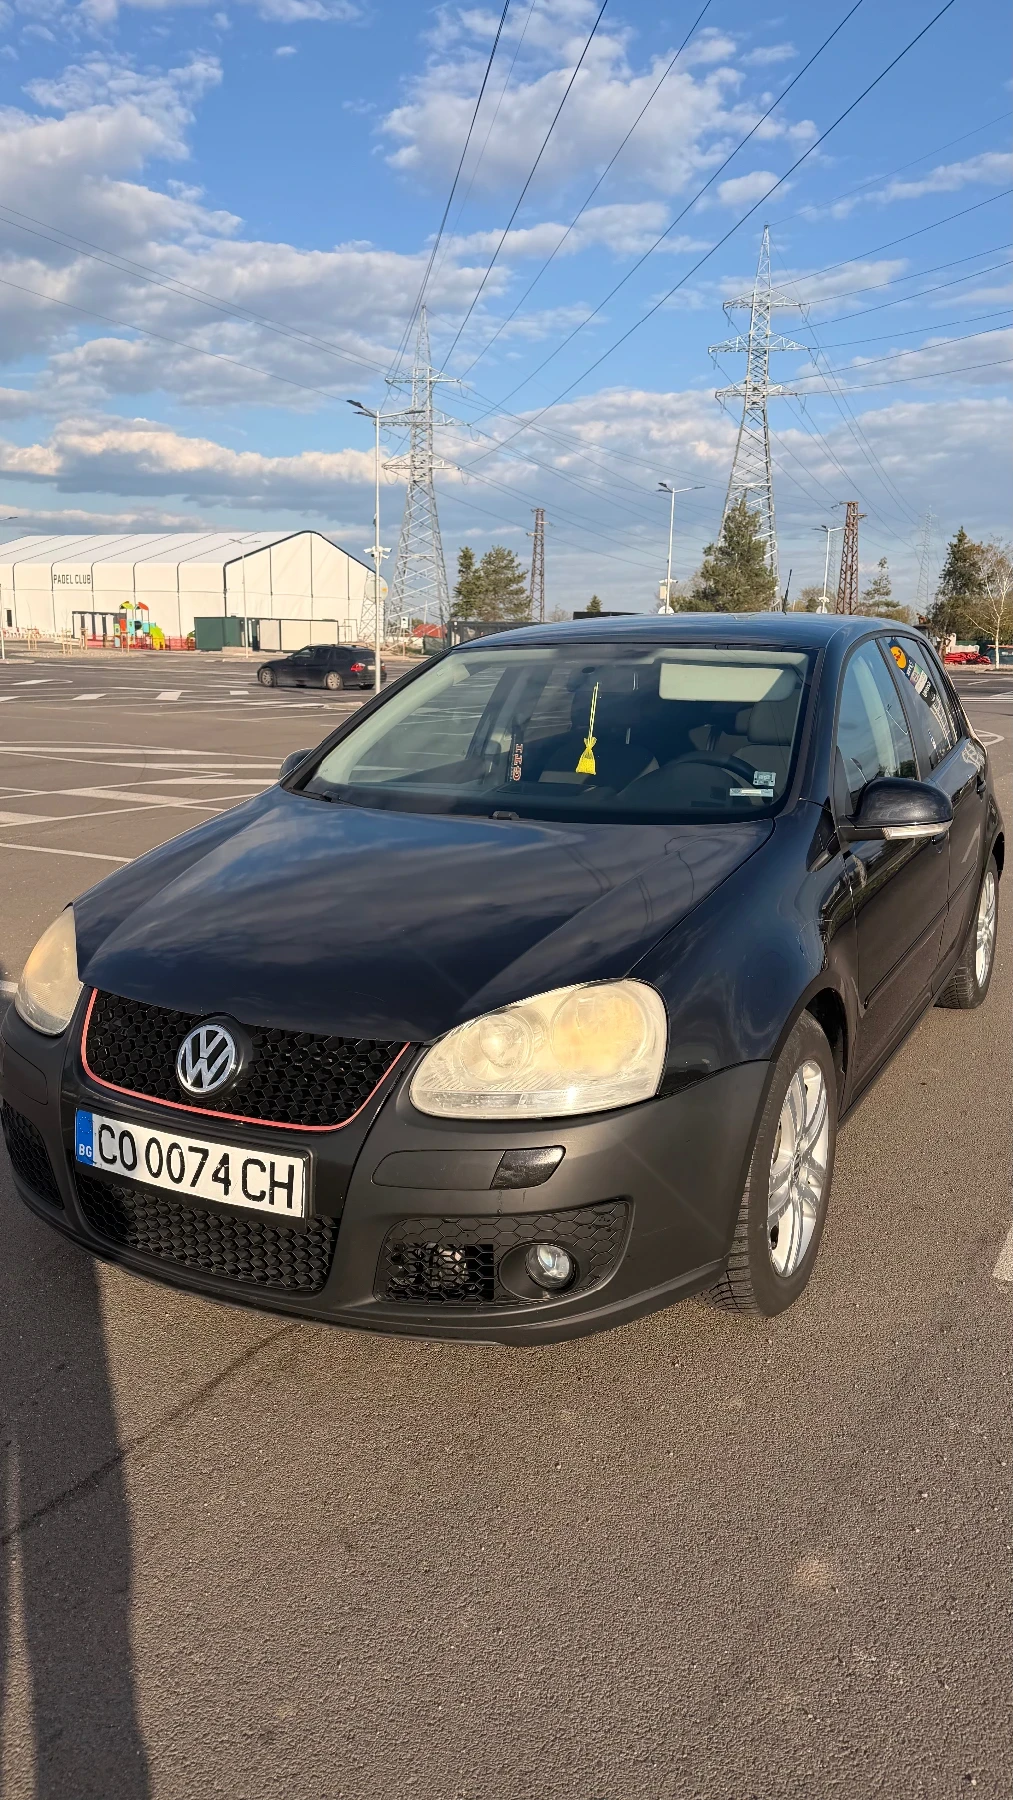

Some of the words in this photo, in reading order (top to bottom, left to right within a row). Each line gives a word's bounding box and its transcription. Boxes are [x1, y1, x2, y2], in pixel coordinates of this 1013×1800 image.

[54, 574, 73, 584] PADEL
[75, 574, 91, 584] CLUB
[512, 743, 523, 780] GTI
[79, 1144, 92, 1158] BG
[145, 1136, 232, 1197] 0074
[241, 1158, 295, 1210] CH
